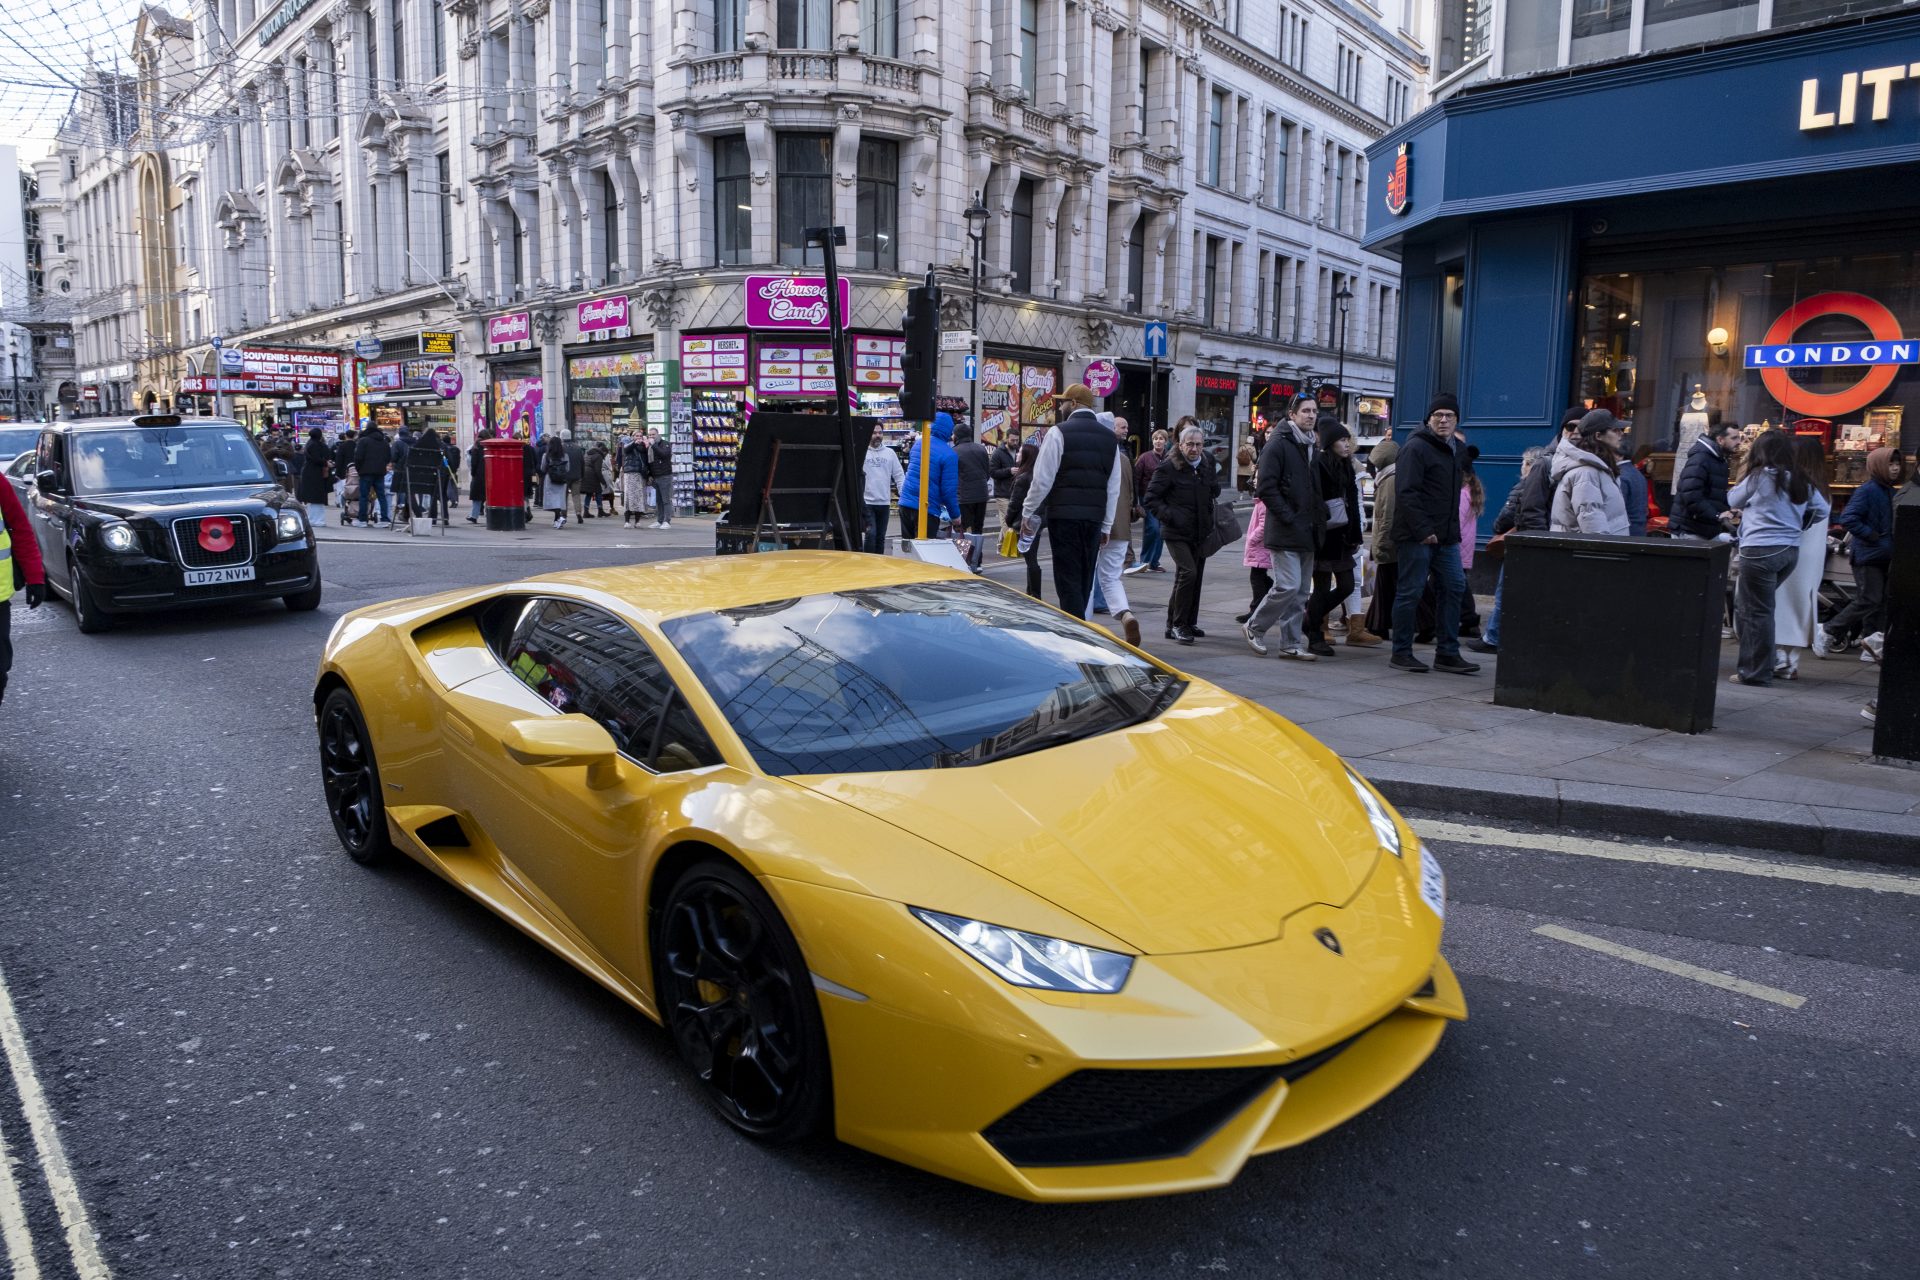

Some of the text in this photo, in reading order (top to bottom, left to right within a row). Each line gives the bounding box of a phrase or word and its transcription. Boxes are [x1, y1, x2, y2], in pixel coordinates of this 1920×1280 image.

[1800, 62, 1920, 130] LIT
[759, 279, 819, 299] House
[768, 298, 828, 325] Candy
[243, 351, 338, 365] SOUVENIRS MEGASTORE
[1754, 344, 1910, 364] LONDON
[982, 363, 1014, 387] House
[1024, 366, 1055, 394] Candy
[1204, 376, 1218, 389] CRAB
[1219, 378, 1236, 390] SHACK
[982, 391, 1008, 406] ERSHEY'S
[188, 568, 250, 584] LD72 NVM
